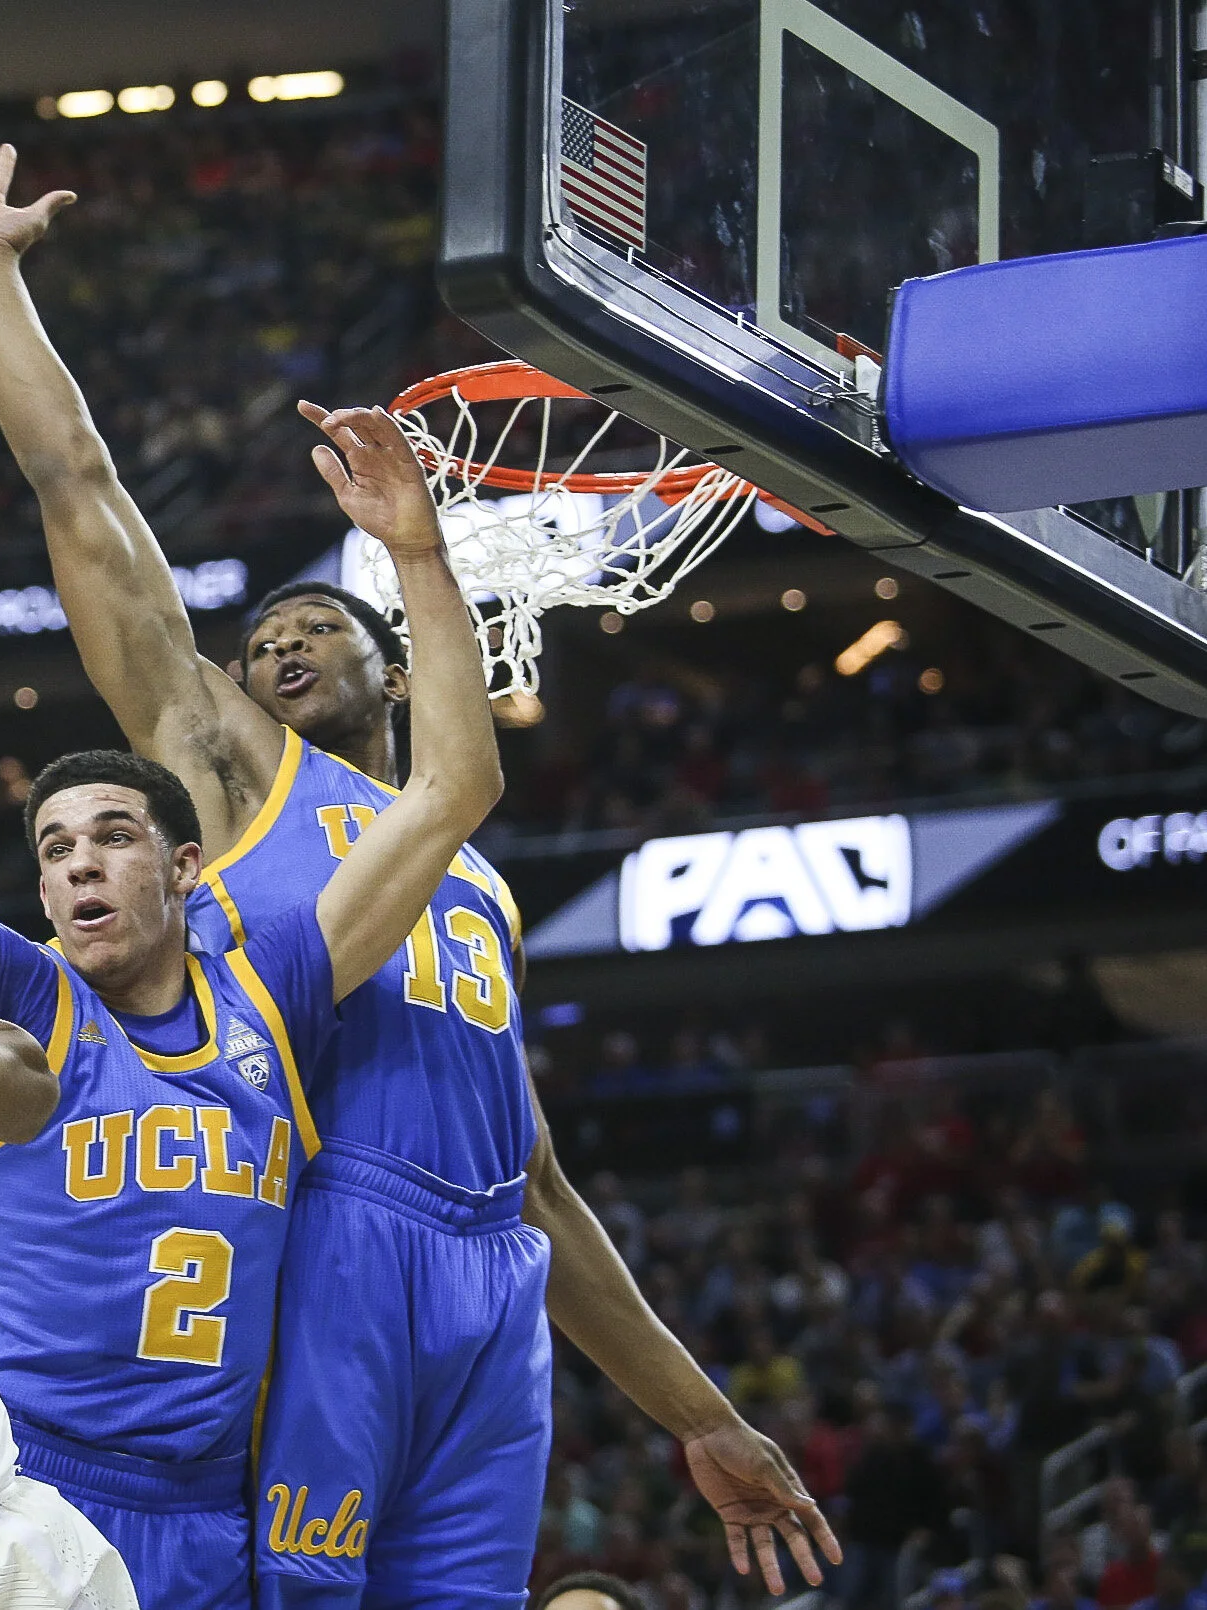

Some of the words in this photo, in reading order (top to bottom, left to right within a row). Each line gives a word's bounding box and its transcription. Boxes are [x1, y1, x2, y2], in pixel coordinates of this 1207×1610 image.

[619, 814, 911, 952] PAC
[404, 904, 511, 1034] 13
[62, 1105, 291, 1209] UCLA
[136, 1226, 234, 1367] 2
[267, 1483, 370, 1558] Ucla
